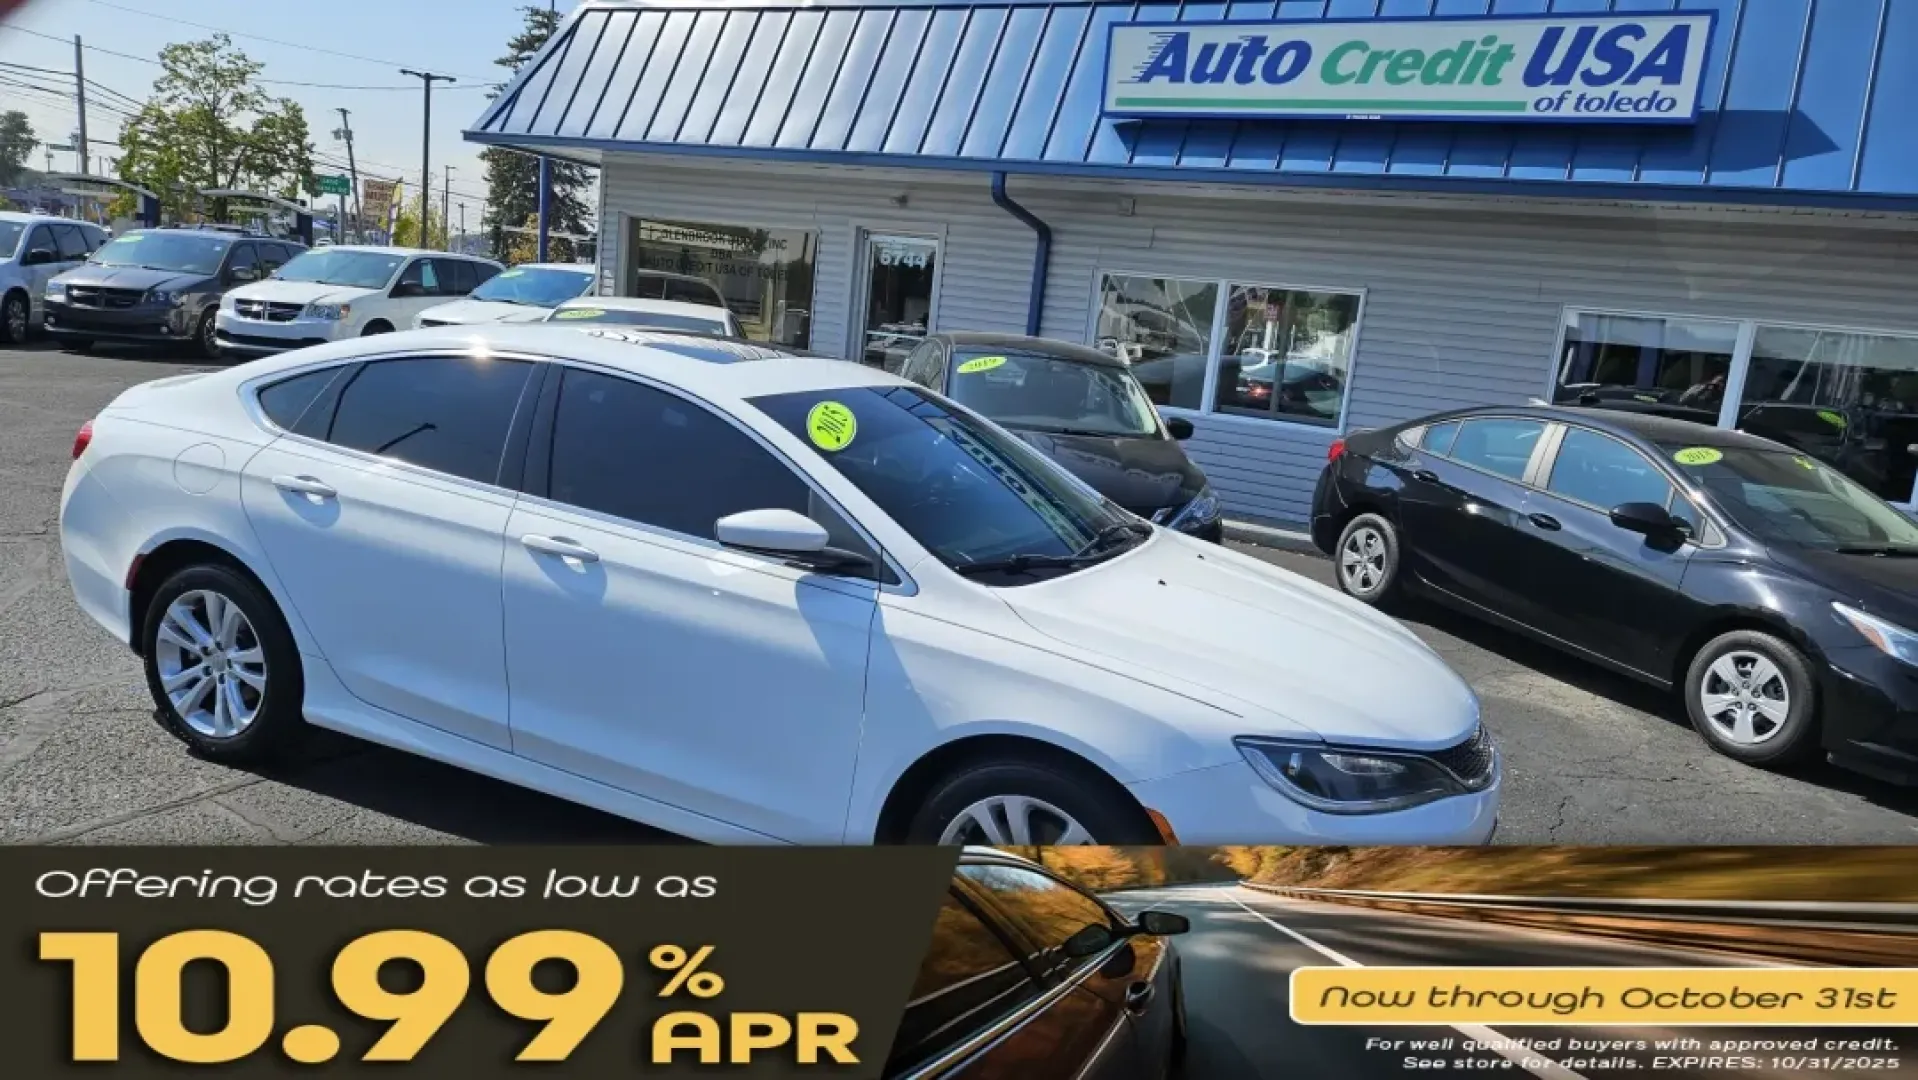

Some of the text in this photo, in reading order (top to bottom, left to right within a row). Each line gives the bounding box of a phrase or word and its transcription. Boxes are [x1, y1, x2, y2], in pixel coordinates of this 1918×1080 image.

[1138, 24, 1696, 88] Auto Credit USA
[1533, 90, 1678, 114] of toledo
